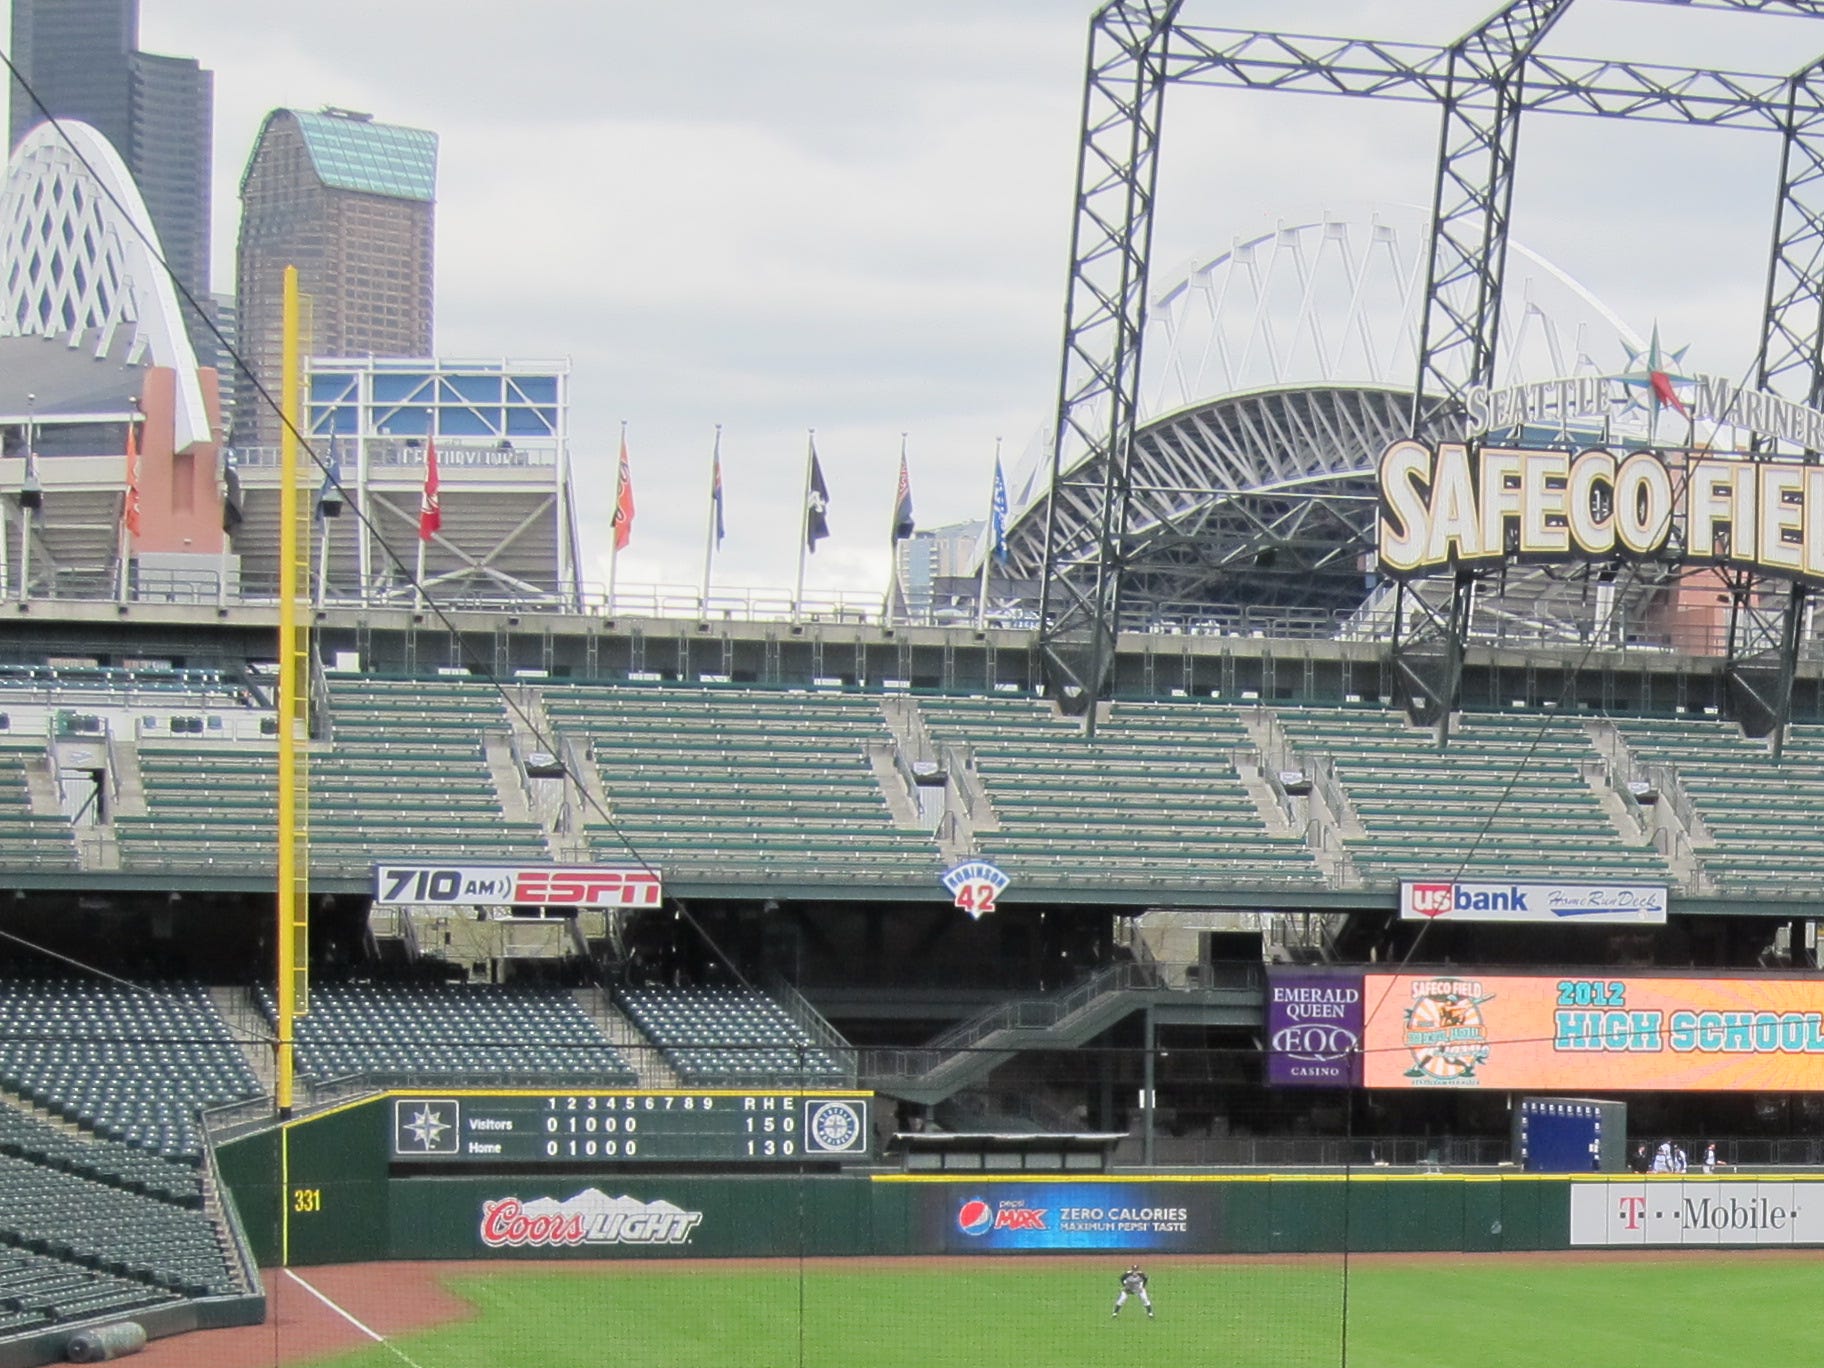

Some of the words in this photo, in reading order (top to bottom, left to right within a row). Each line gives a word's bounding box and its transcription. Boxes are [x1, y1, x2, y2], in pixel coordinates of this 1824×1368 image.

[1465, 378, 1612, 440] SEATTLE
[1378, 438, 1674, 576] SAFECO
[385, 870, 463, 901] 710
[464, 879, 495, 896] AM
[514, 872, 661, 904] ESPN
[955, 884, 996, 911] 42
[1454, 885, 1528, 911] bank
[1273, 987, 1359, 1003] EMERALD
[1412, 981, 1452, 998] SAFECO
[1453, 981, 1482, 998] FIELD
[1557, 981, 1626, 1007] 2012
[1286, 1003, 1345, 1021] QUEEN
[1554, 1009, 1663, 1052] HIGH
[1290, 1066, 1340, 1077] CASINO
[548, 1097, 556, 1111] 1
[567, 1097, 577, 1111] 2
[587, 1097, 597, 1111] 3
[606, 1097, 616, 1111] 4
[625, 1097, 636, 1111] 5
[644, 1097, 655, 1111] 6
[664, 1097, 674, 1111] 7
[683, 1097, 694, 1111] 8
[703, 1097, 713, 1111] 9
[744, 1097, 756, 1111] R
[763, 1097, 776, 1111] H
[783, 1097, 794, 1111] E
[469, 1118, 513, 1131] Visitors
[546, 1117, 558, 1133] 0
[569, 1117, 577, 1133] 1
[585, 1117, 597, 1133] 0
[605, 1117, 617, 1133] 0
[624, 1117, 637, 1133] 0
[746, 1117, 754, 1133] 1
[763, 1117, 776, 1133] 5
[782, 1117, 795, 1133] 0
[468, 1141, 502, 1154] Home
[546, 1140, 558, 1156] 0
[569, 1140, 577, 1156] 1
[585, 1140, 597, 1156] 0
[605, 1140, 617, 1156] 0
[624, 1140, 637, 1156] 0
[746, 1140, 754, 1156] 1
[763, 1140, 776, 1156] 3
[782, 1140, 795, 1156] 0
[294, 1188, 321, 1212] 331
[999, 1200, 1025, 1209] pepsi
[482, 1198, 586, 1245] Coors
[586, 1212, 700, 1243] LIGHT
[994, 1209, 1048, 1231] MAX
[1060, 1208, 1103, 1221] ZERO
[1108, 1208, 1188, 1221] CALORIES
[1060, 1222, 1115, 1232] MAXIMUM
[1117, 1222, 1147, 1232] PEPSI
[1152, 1222, 1187, 1232] TASTE
